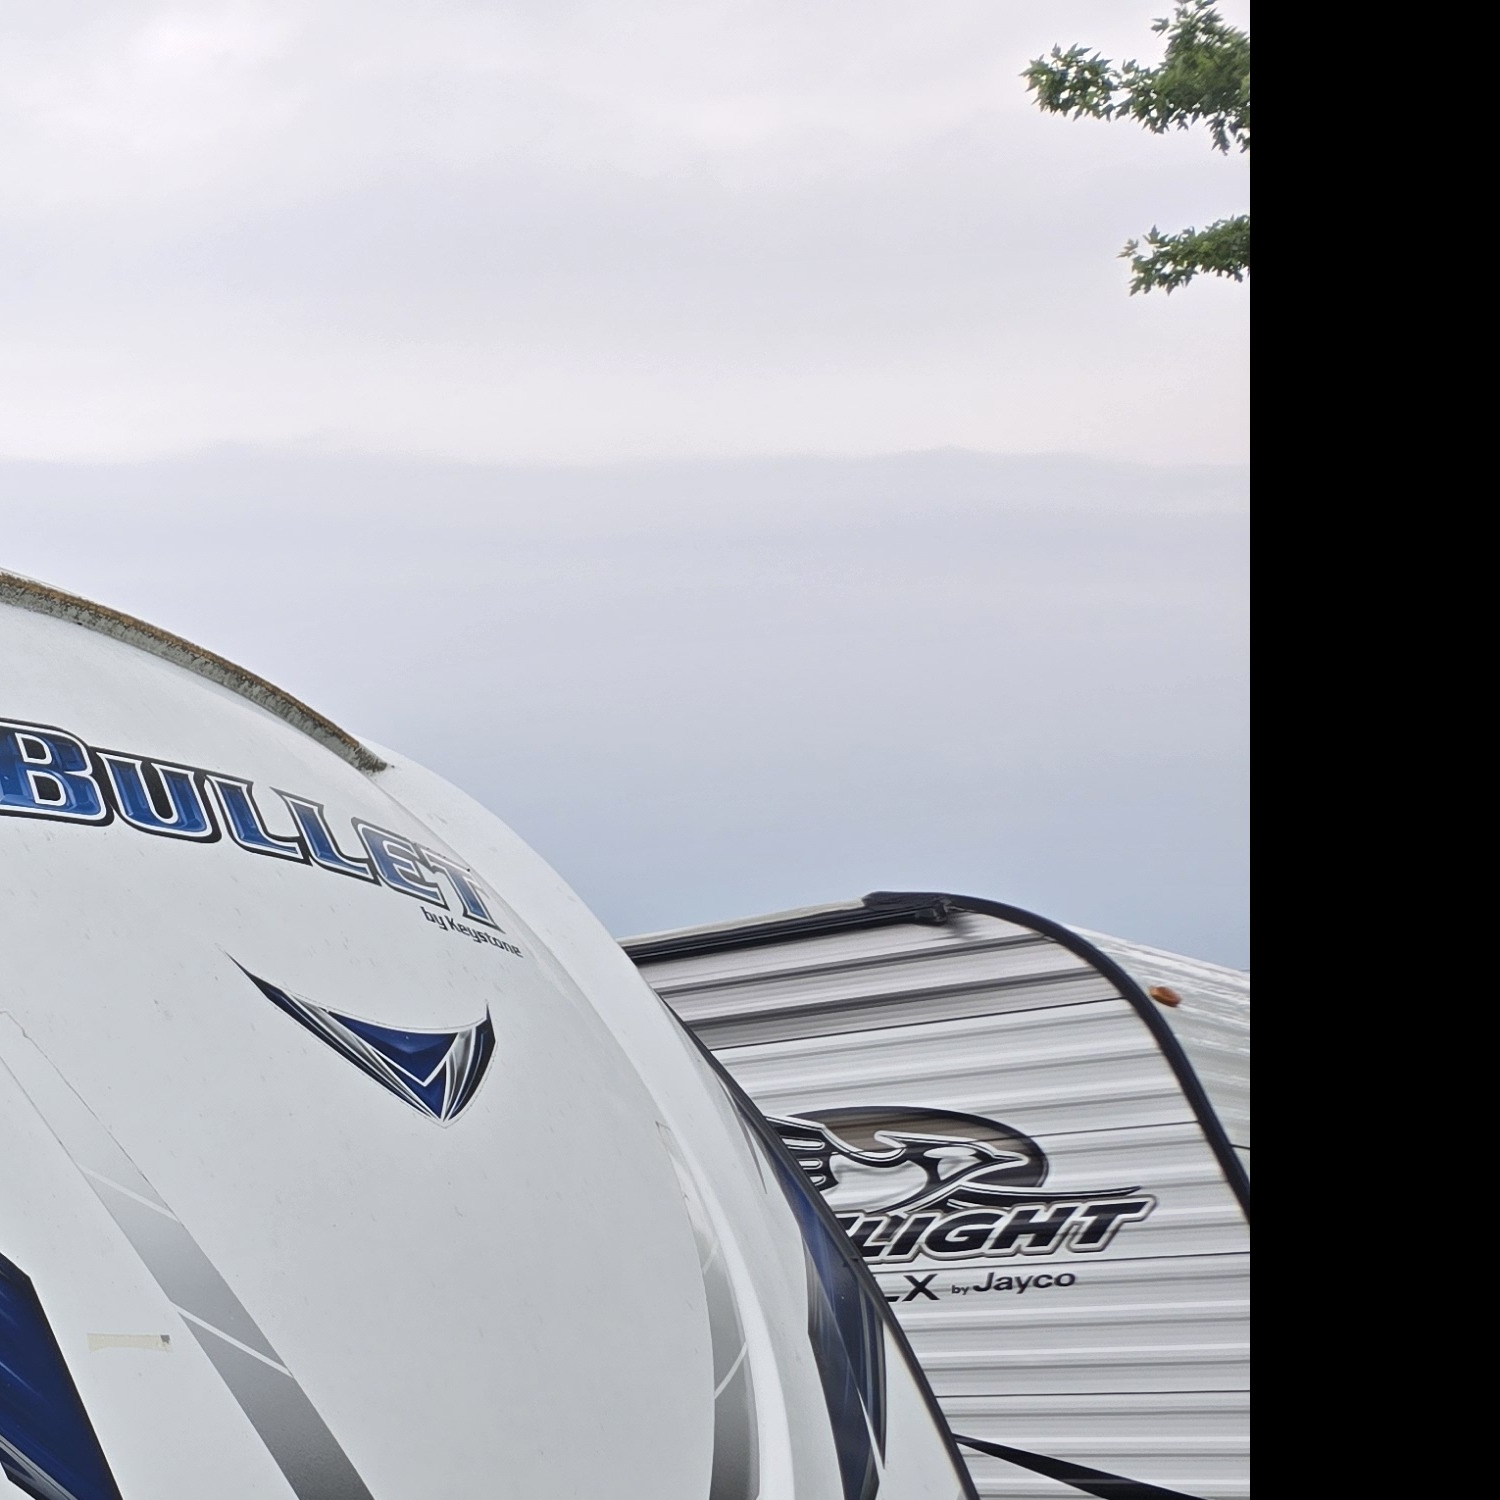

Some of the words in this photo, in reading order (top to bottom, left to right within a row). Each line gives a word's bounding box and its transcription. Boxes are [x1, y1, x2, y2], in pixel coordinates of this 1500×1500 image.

[420, 905, 449, 932] by
[444, 914, 524, 959] Keystone
[836, 1194, 1157, 1264] LIGHT
[951, 1284, 968, 1296] by
[972, 1272, 1077, 1295] Jayco
